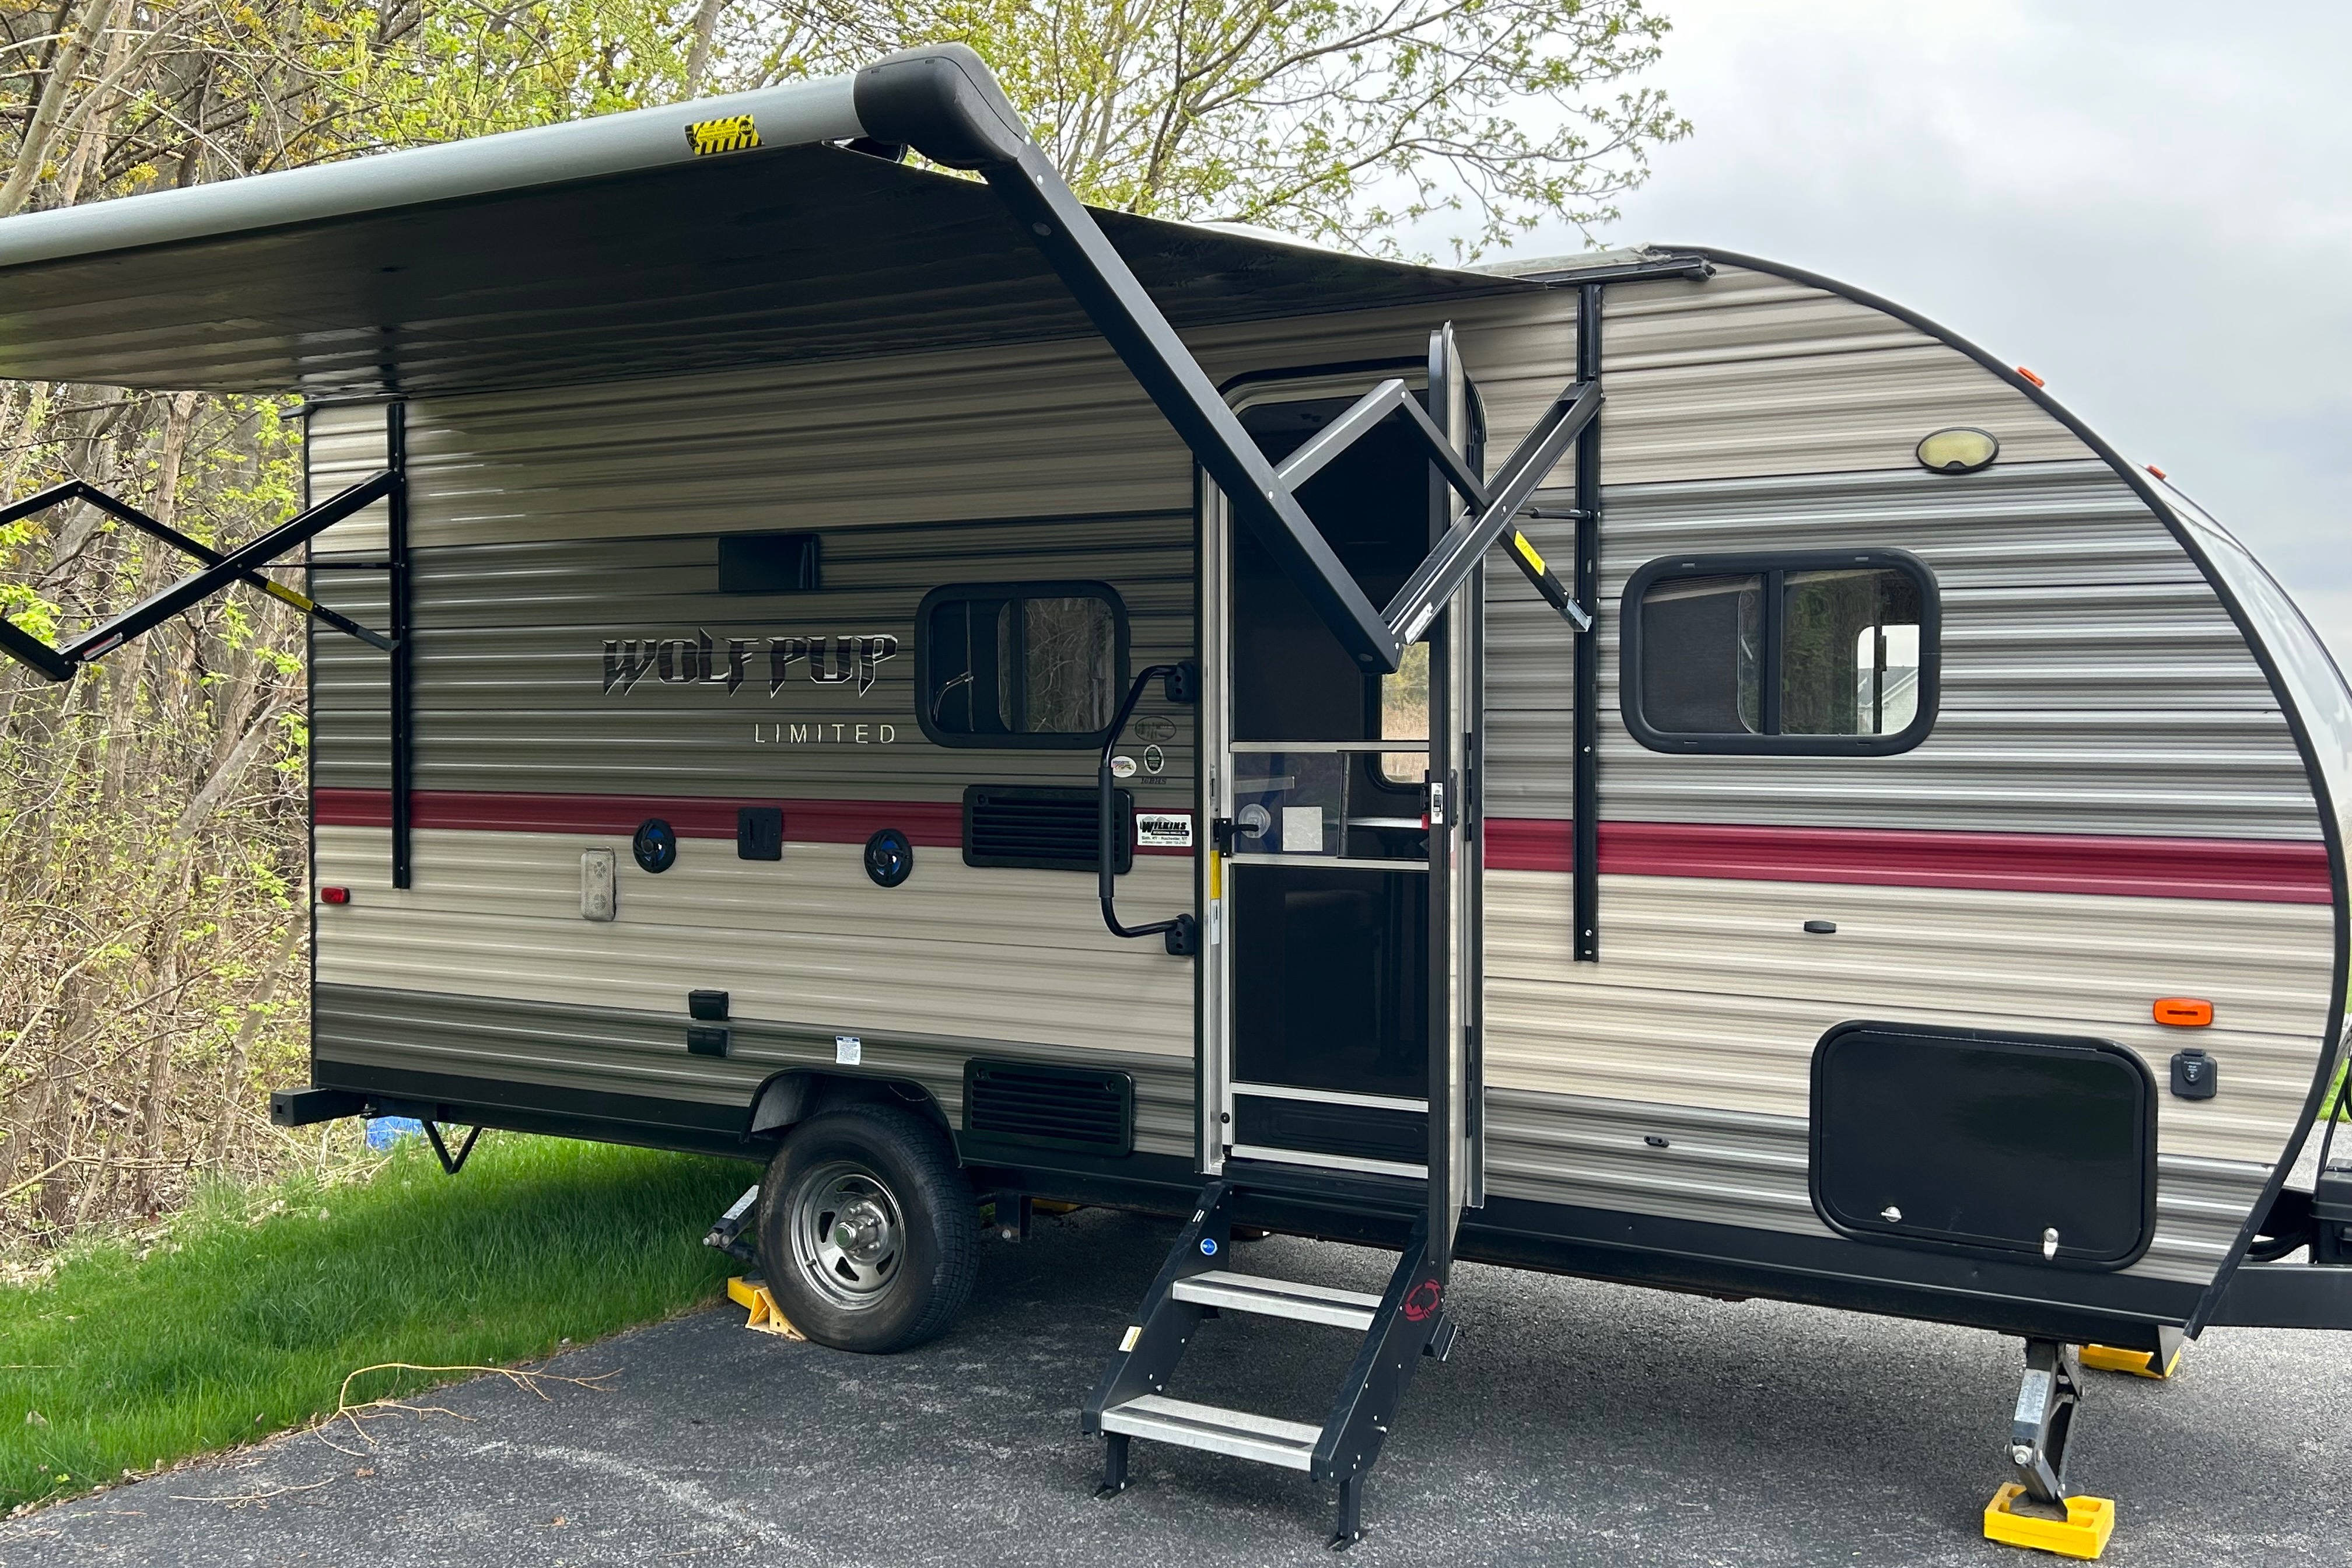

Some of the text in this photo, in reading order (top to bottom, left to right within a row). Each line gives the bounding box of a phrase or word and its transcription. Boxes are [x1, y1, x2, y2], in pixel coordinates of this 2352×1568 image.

[602, 626, 898, 699] WOLF PUP
[755, 723, 895, 744] LIMITED
[1142, 821, 1186, 833] WILKINS
